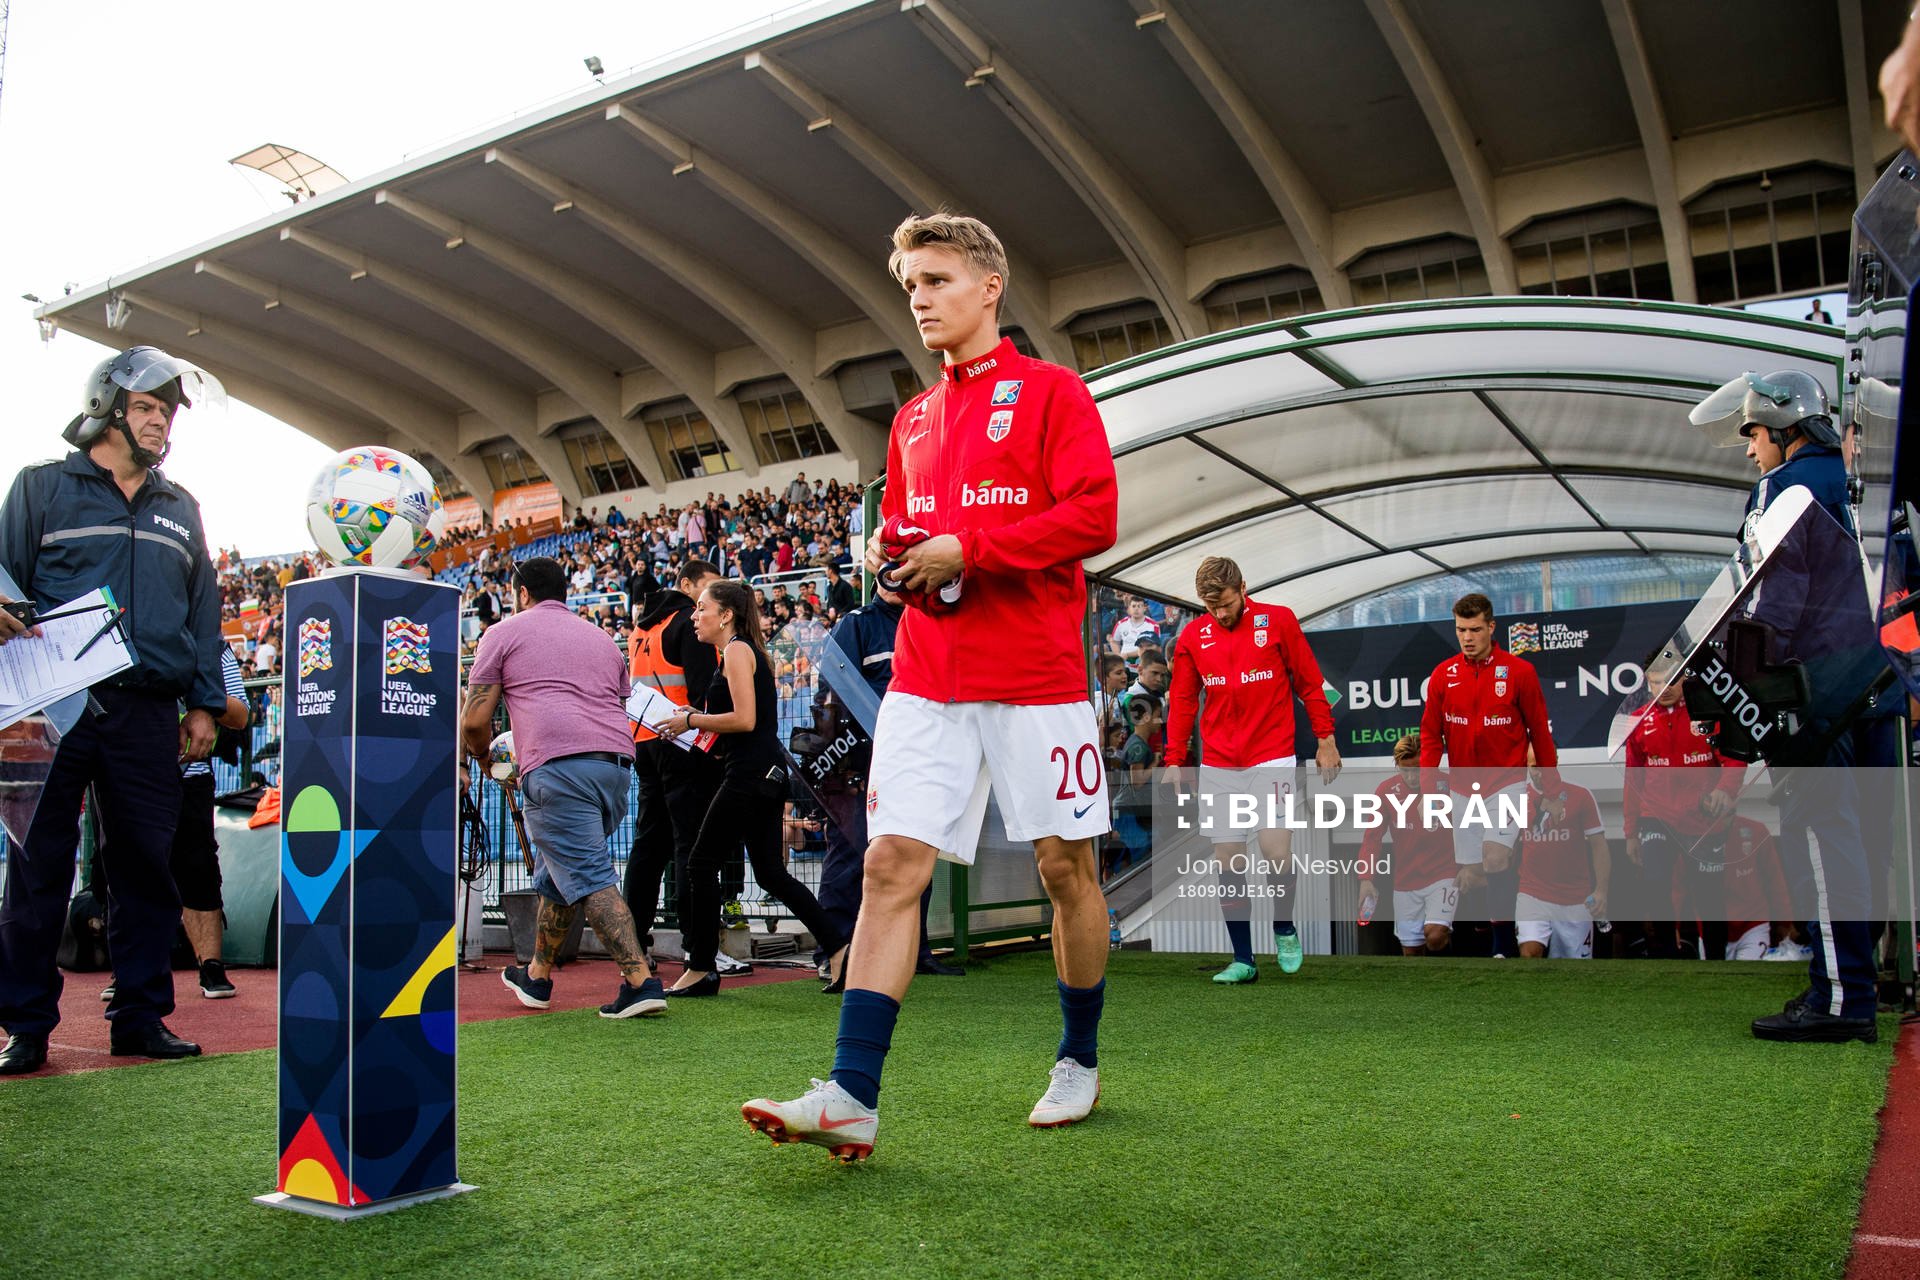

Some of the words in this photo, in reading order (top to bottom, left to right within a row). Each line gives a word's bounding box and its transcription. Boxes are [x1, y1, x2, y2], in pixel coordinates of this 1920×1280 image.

[153, 514, 191, 541] POLICE
[1543, 624, 1569, 635] UEFA
[1543, 630, 1590, 643] NATIONS
[635, 637, 651, 657] 74
[1543, 639, 1585, 651] LEAGUE
[387, 680, 413, 692] UEFA
[1578, 662, 1652, 697] NO
[301, 682, 319, 693] UEFA
[297, 690, 337, 705] NATIONS
[381, 690, 437, 706] NATIONS
[1700, 657, 1774, 742] POLICE
[297, 704, 332, 717] LEAGUE
[381, 702, 431, 717] LEAGUE
[809, 728, 858, 780] POLICE
[1050, 742, 1101, 801] 20
[1441, 887, 1457, 908] 16
